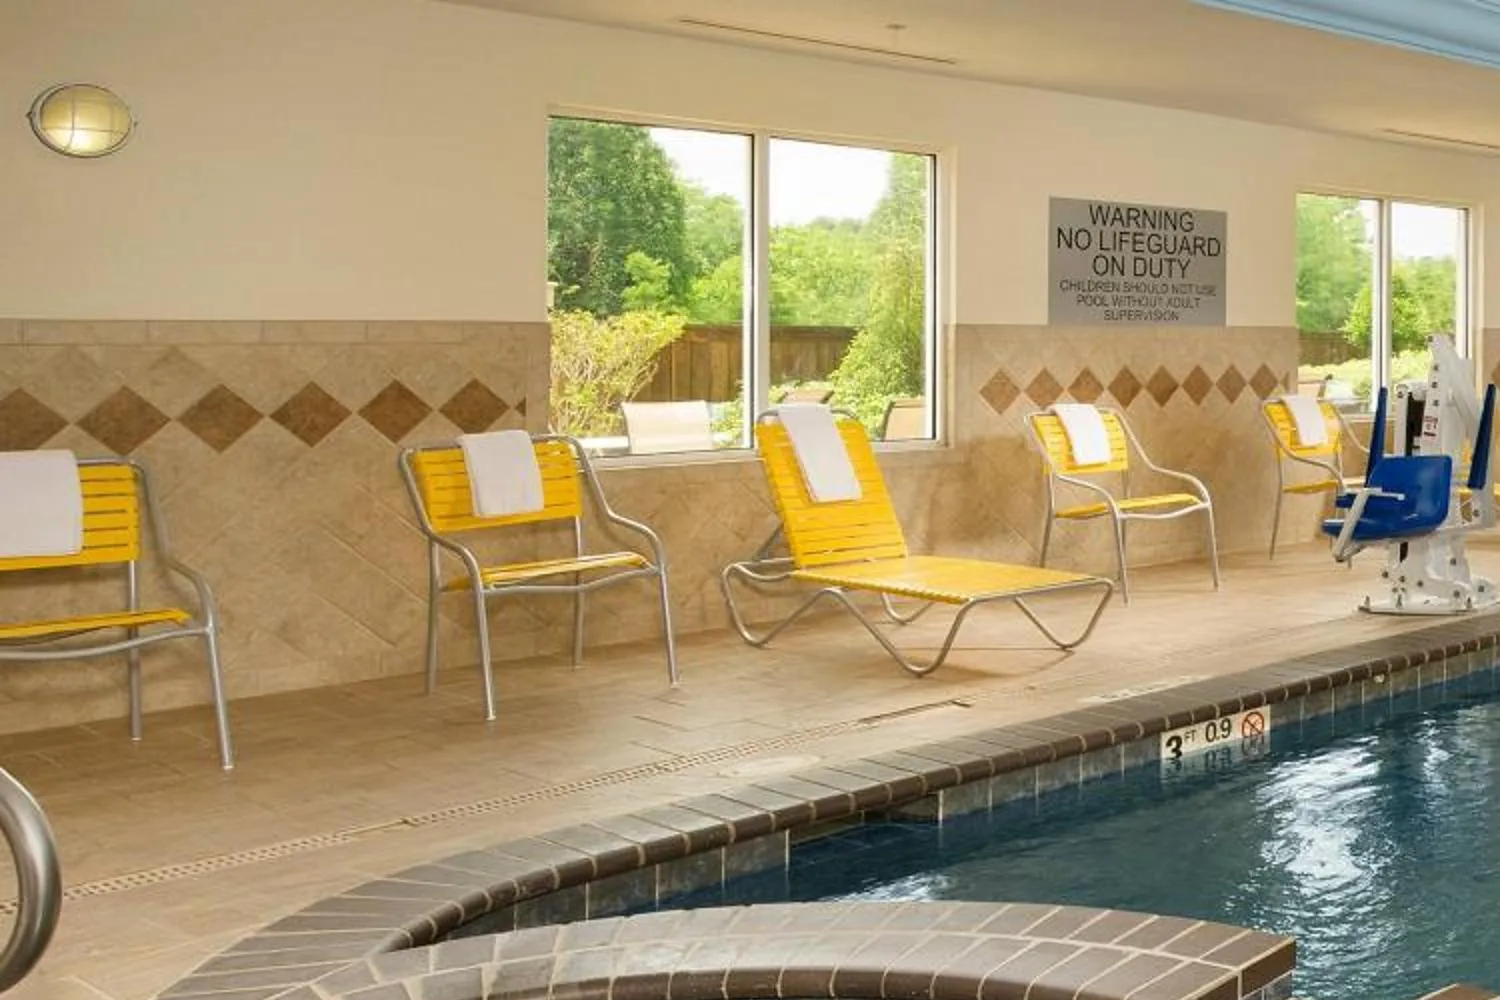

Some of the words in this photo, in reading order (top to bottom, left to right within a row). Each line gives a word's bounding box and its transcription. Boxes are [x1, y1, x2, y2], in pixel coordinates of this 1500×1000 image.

[1089, 204, 1194, 232] WARNING
[1057, 227, 1092, 251] NO
[1099, 230, 1221, 257] LIFEGUARD
[1092, 254, 1125, 276] ON
[1133, 257, 1190, 279] DUTY
[1059, 279, 1119, 293] CHILDREN
[1123, 281, 1169, 295] SHOULD
[1076, 293, 1109, 307] POOL
[1112, 295, 1163, 308] WITHOUT
[1166, 297, 1201, 309] ADULT
[1104, 309, 1179, 321] SUPERVISION
[1165, 735, 1183, 760] 3
[1184, 729, 1197, 742] FT
[1205, 718, 1232, 743] 0.9
